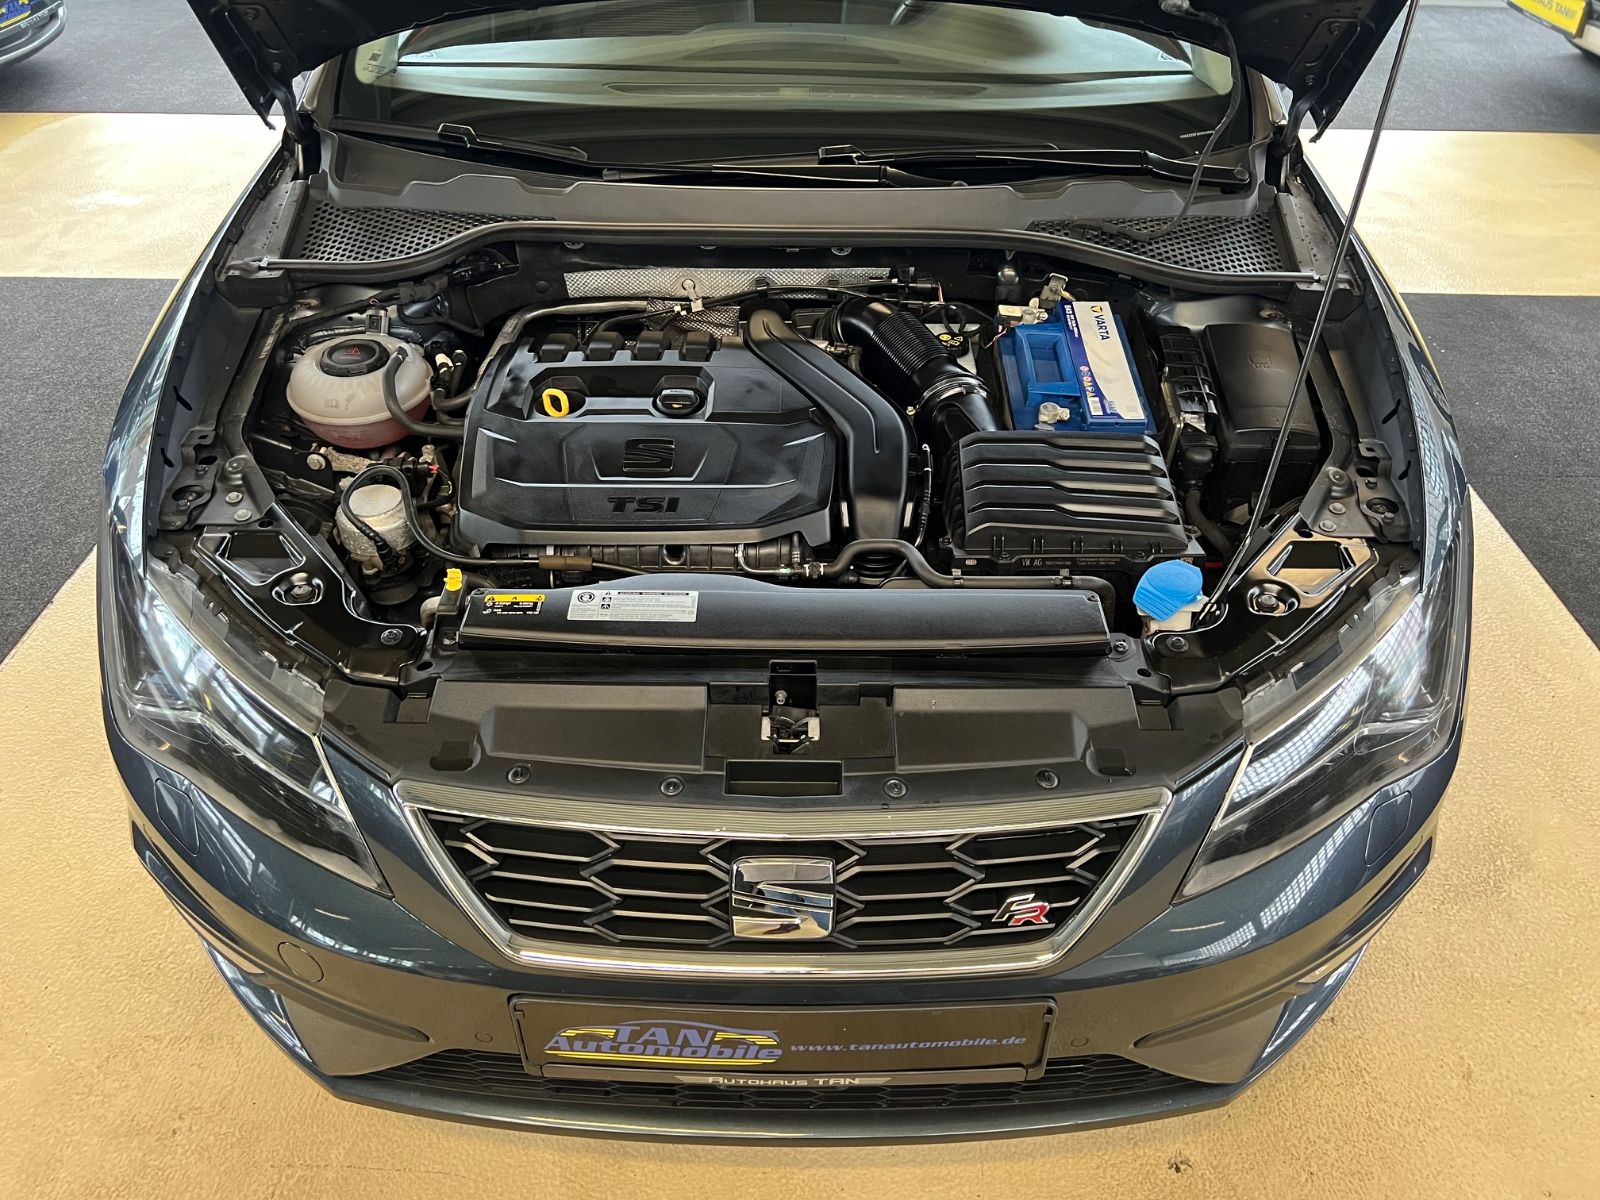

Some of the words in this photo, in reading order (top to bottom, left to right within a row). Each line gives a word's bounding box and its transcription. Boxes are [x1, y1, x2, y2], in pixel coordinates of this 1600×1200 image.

[1094, 314, 1111, 340] VARTA
[607, 496, 680, 513] TSI
[1033, 558, 1043, 567] AG
[991, 893, 1050, 927] FR
[614, 1025, 714, 1047] TAN
[790, 1036, 1027, 1052] www.tanautomobile.de
[543, 1035, 783, 1060] Automobile
[709, 1076, 808, 1086] AUTOHAUS
[813, 1077, 860, 1085] TAN
